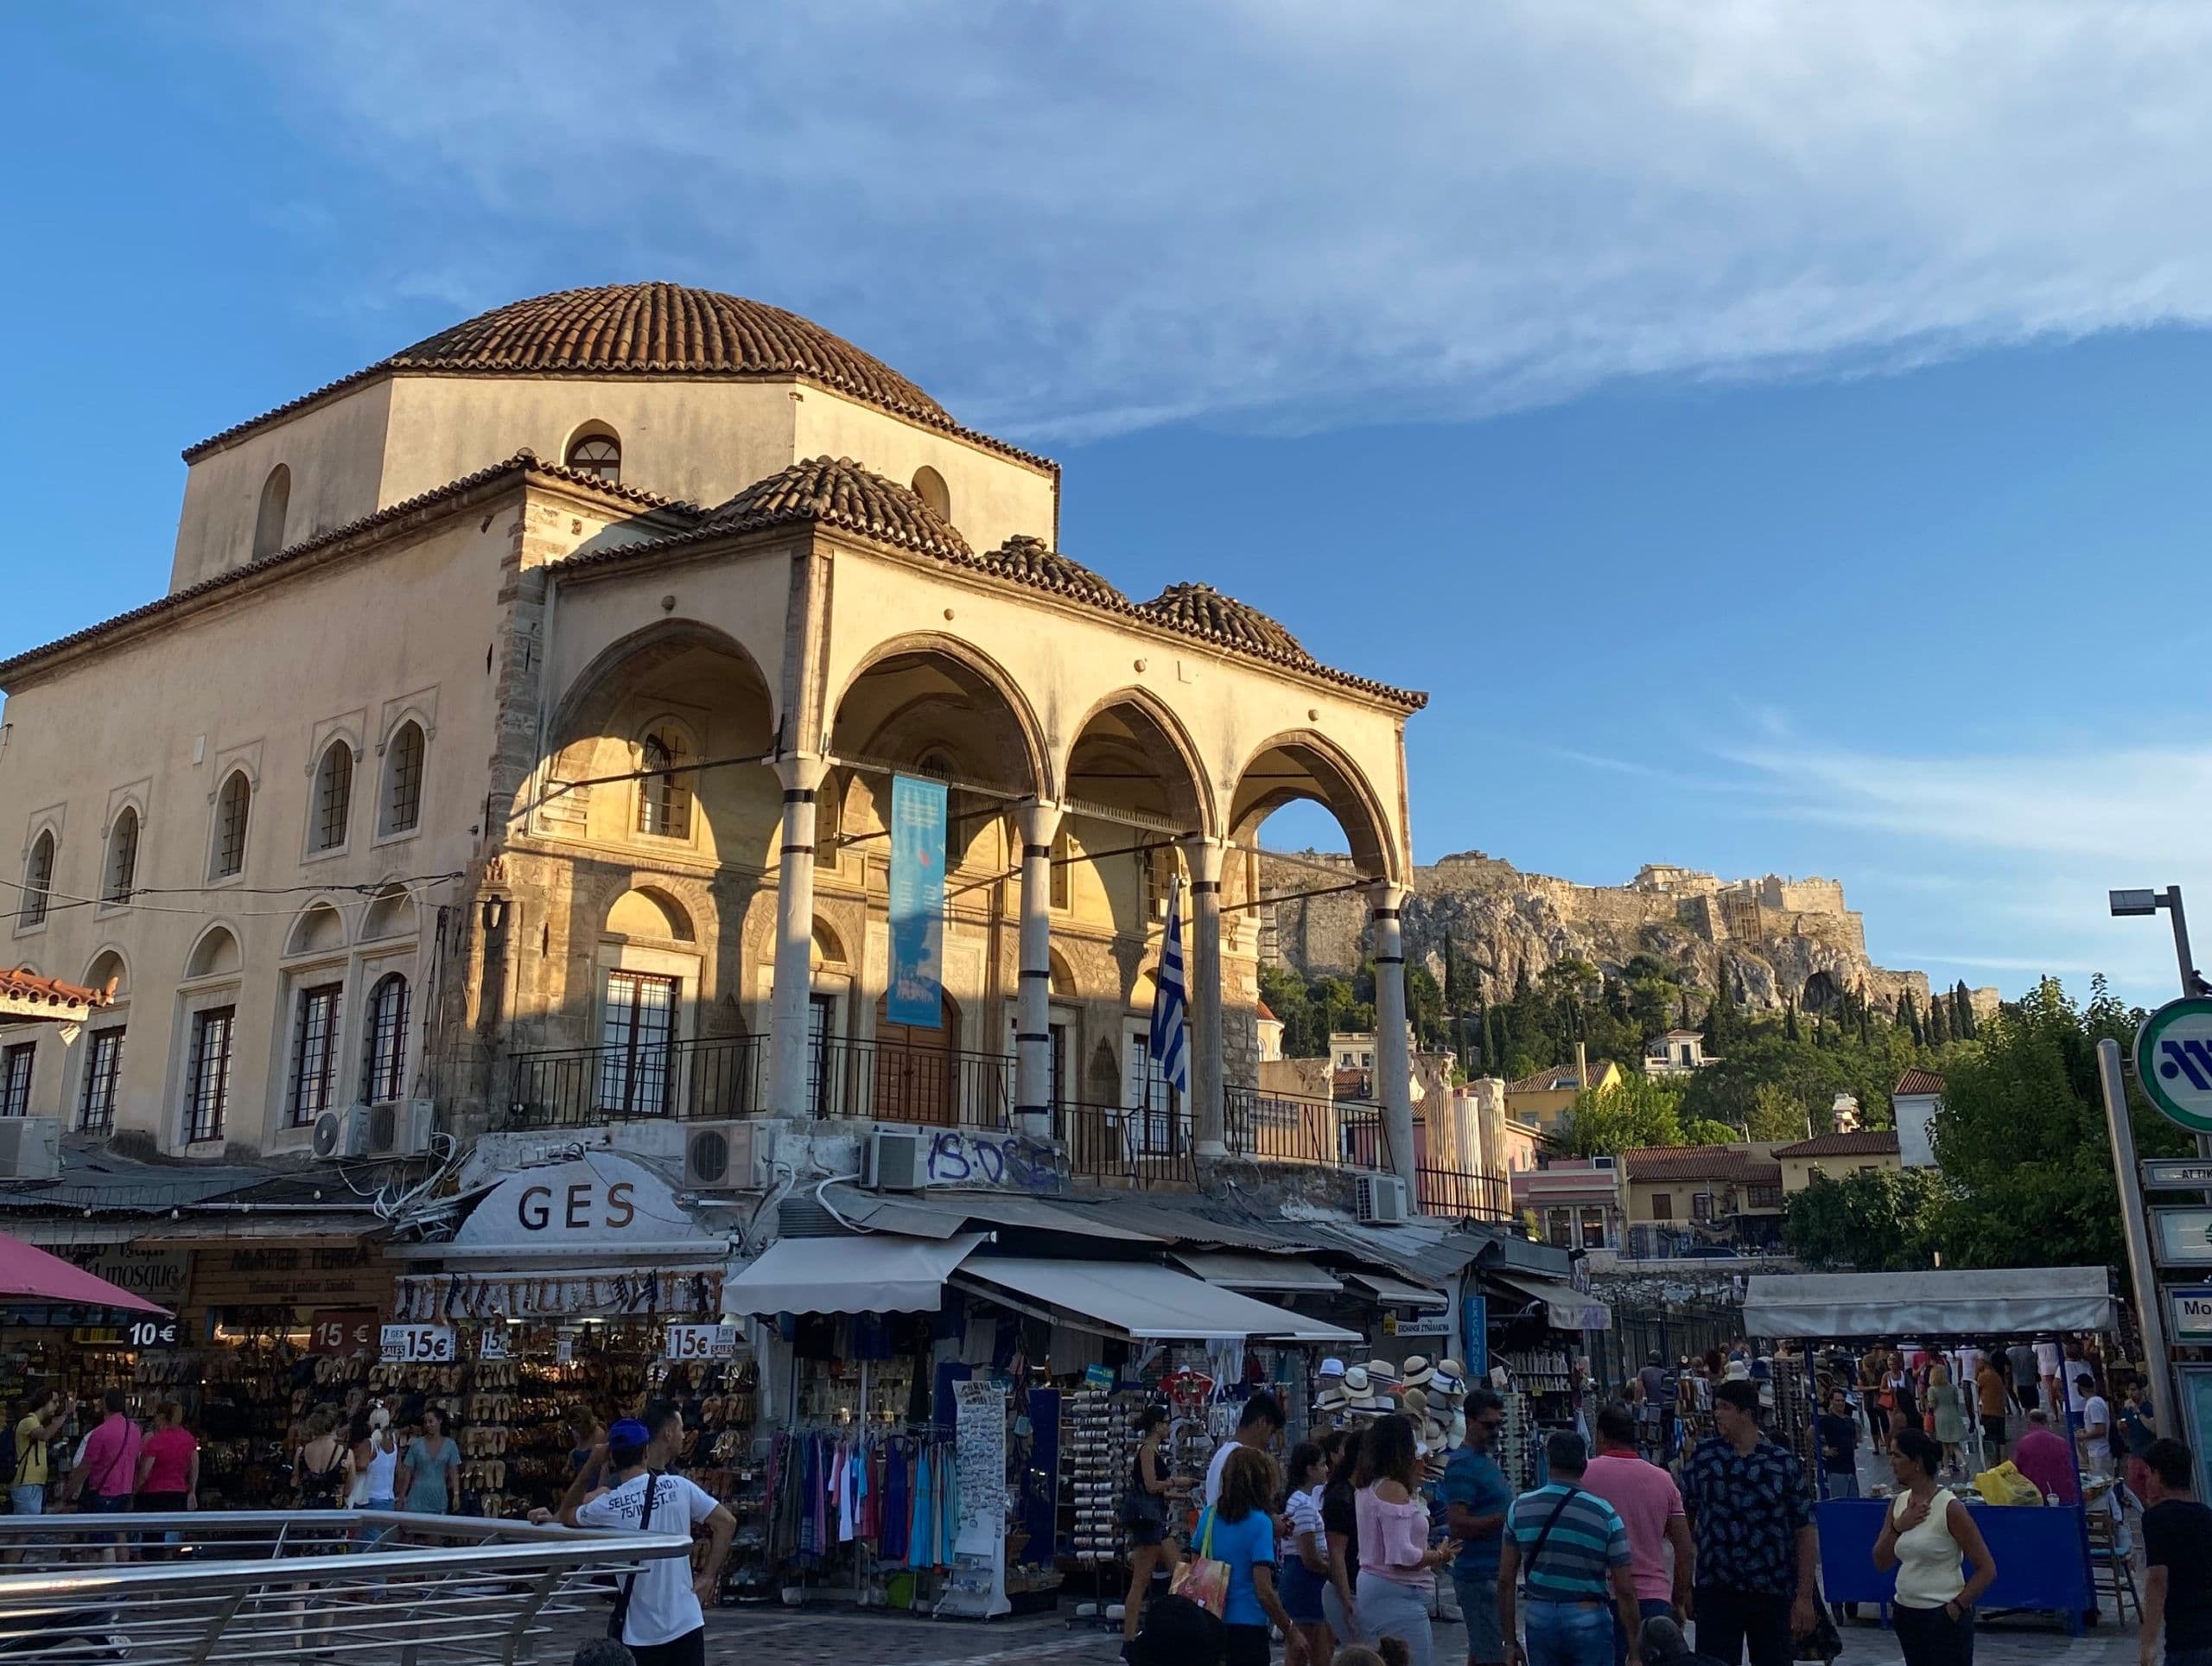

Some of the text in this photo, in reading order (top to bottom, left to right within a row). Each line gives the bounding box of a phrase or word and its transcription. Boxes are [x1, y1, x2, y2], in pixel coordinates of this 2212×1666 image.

[518, 1183, 633, 1230] GES
[407, 1331, 448, 1358] 15€
[674, 1329, 708, 1356] 15€
[712, 1345, 734, 1354] SALES
[1471, 1299, 1480, 1376] EXCHANGE
[381, 1347, 404, 1357] SALES
[608, 1491, 641, 1510] SELECT
